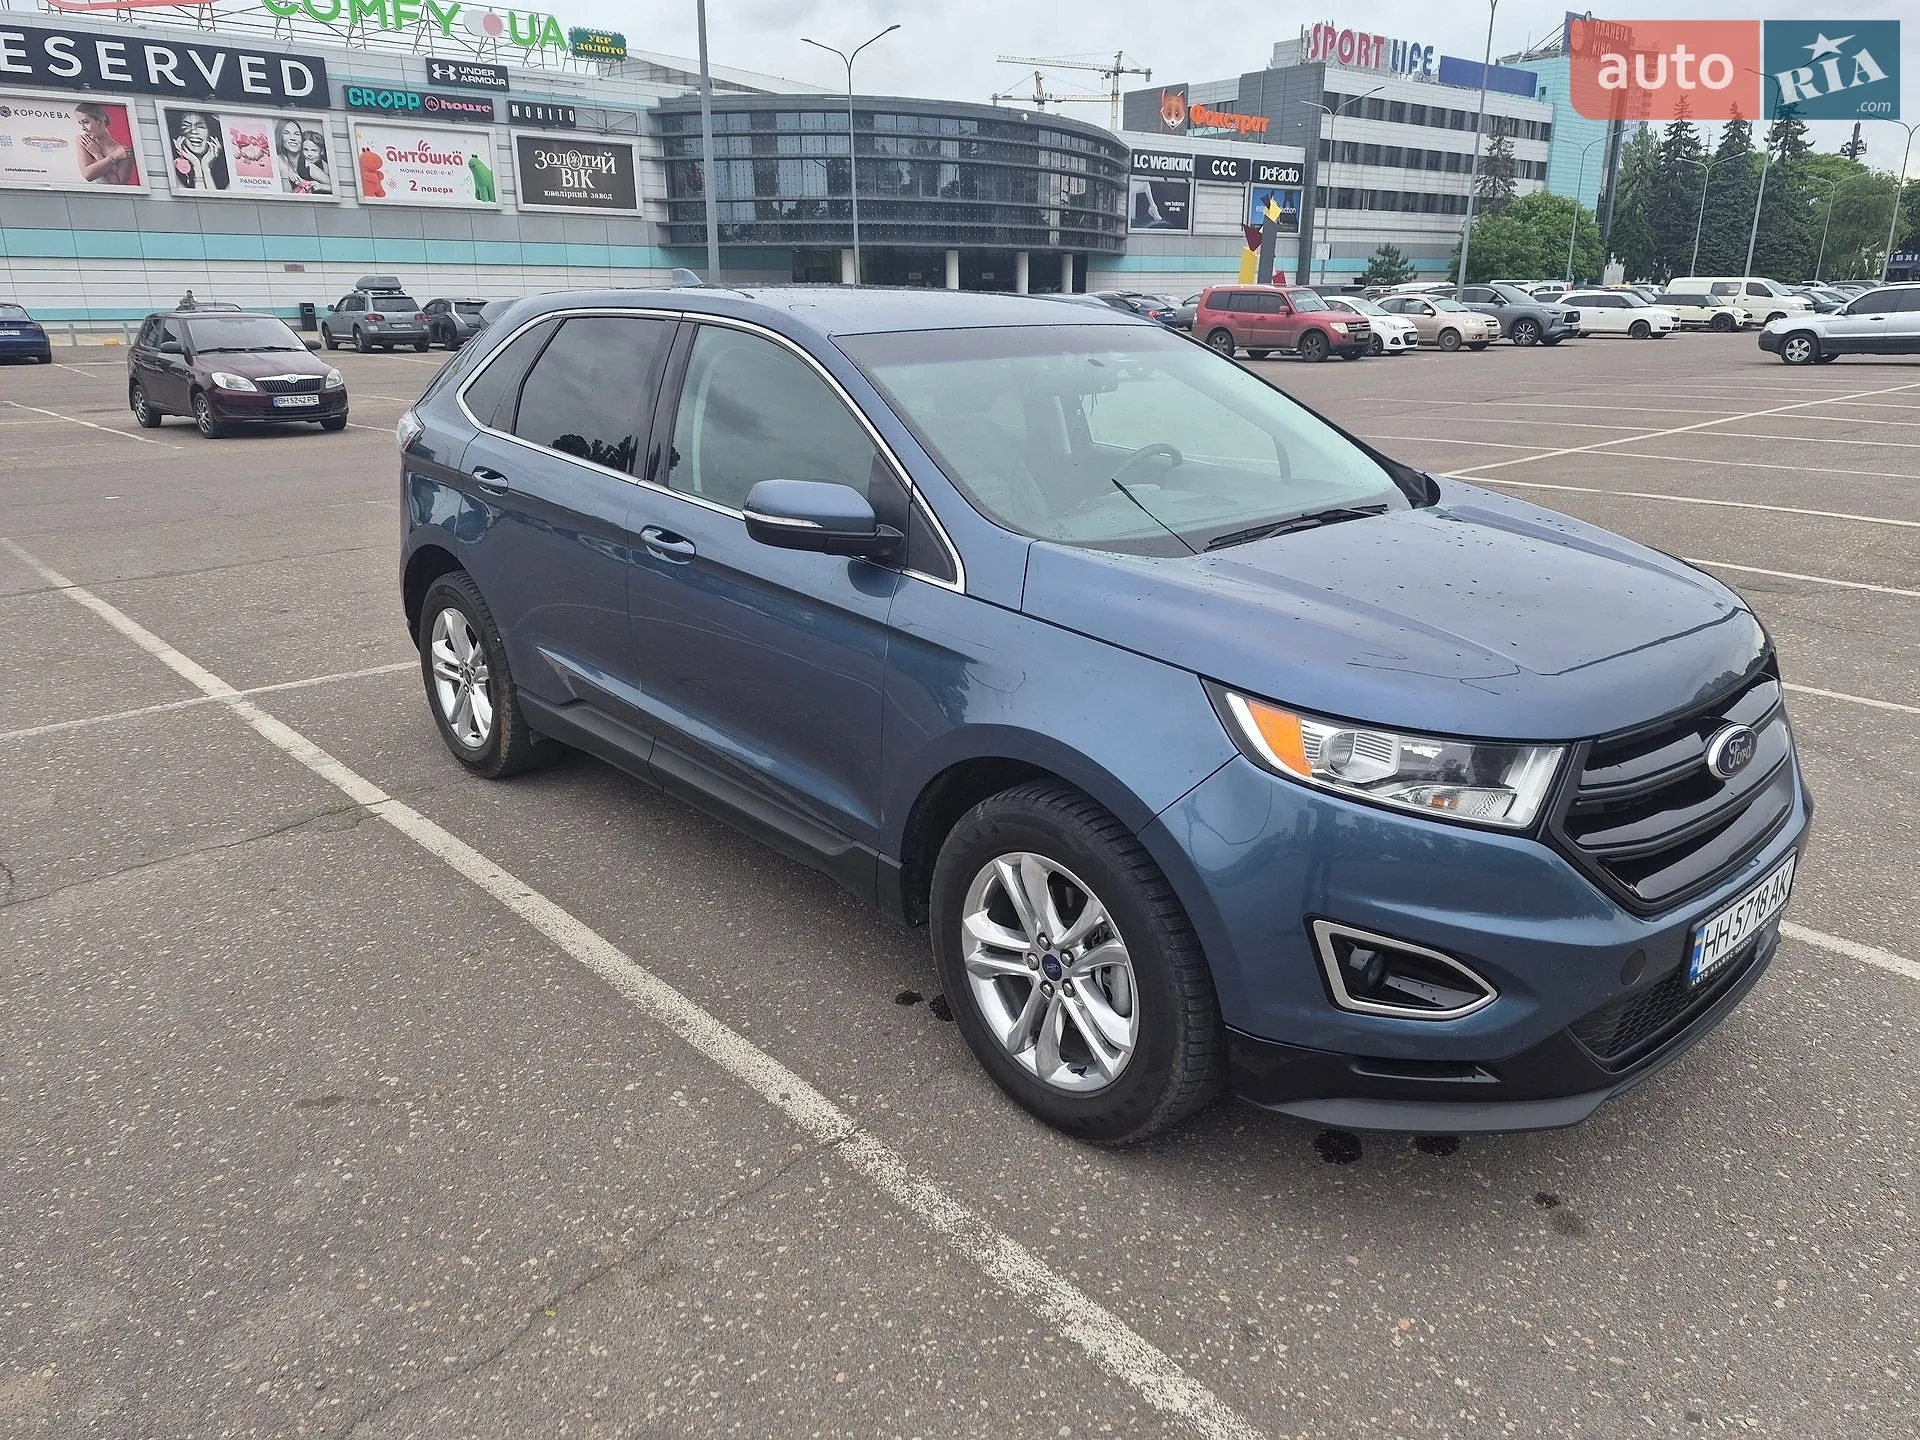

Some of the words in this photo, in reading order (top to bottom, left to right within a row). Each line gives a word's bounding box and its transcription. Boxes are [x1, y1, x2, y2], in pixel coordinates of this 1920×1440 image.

[588, 35, 612, 44] УКР
[576, 43, 624, 55] ЗОЛОТО
[1311, 23, 1384, 68] SPORT
[1392, 39, 1434, 76] LIFE
[0, 32, 314, 97] ESERVED
[459, 66, 495, 77] UNDER
[461, 76, 506, 86] ARMOUR
[348, 87, 421, 111] CROPP
[13, 109, 71, 119] КОРОЛЕВА
[511, 104, 575, 122] MOHITO
[1134, 154, 1149, 168] LC
[1211, 160, 1237, 176] CCC
[1260, 166, 1299, 182] DeFacto
[409, 180, 418, 191] 2
[421, 186, 454, 194] поверх
[544, 189, 588, 199] ювелірний
[590, 192, 613, 200] завод
[1728, 736, 1752, 769] Ford
[1701, 913, 1733, 965] HH
[1733, 884, 1769, 941] 5718
[1768, 863, 1792, 911] AK
